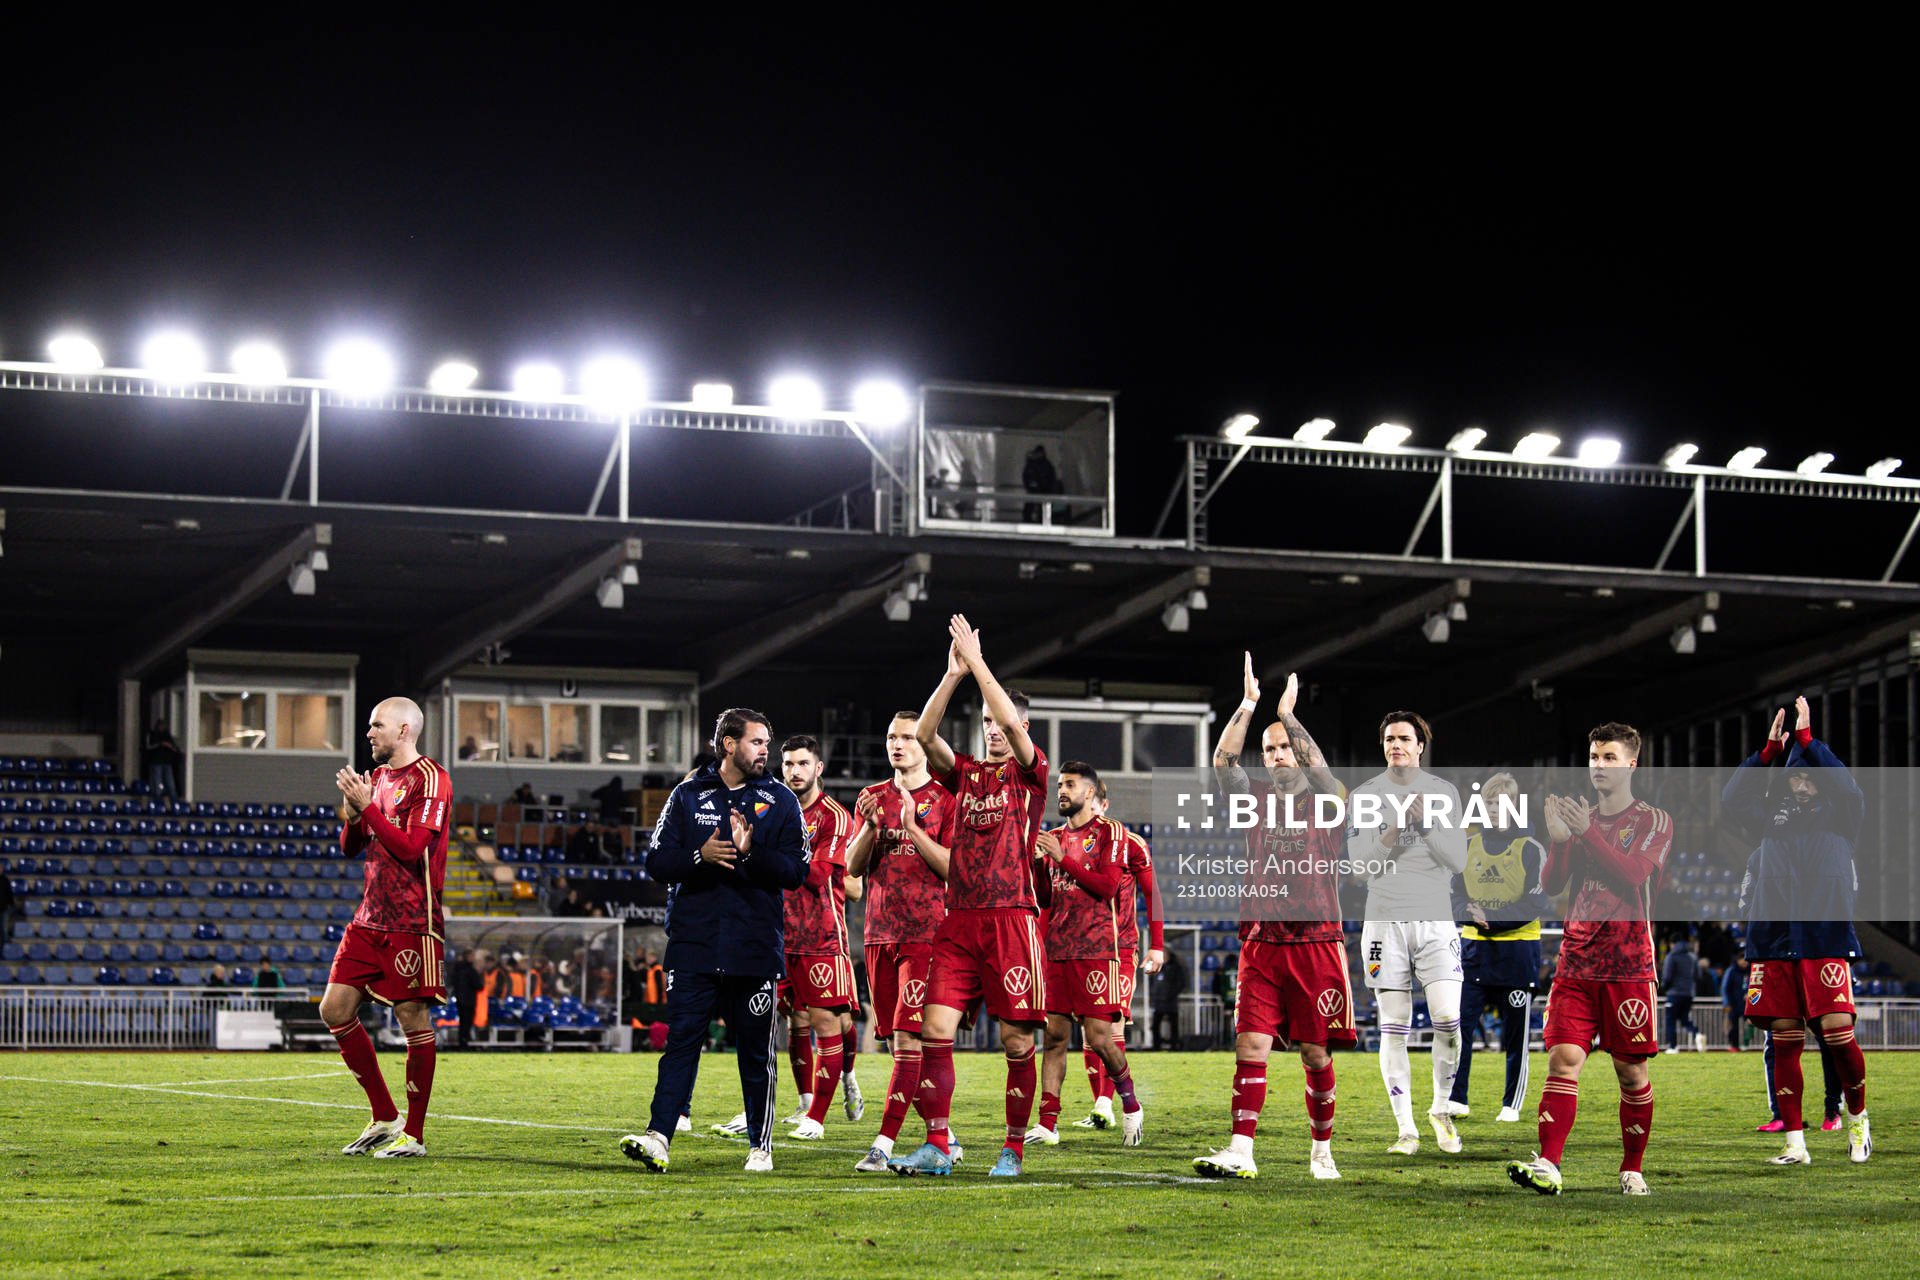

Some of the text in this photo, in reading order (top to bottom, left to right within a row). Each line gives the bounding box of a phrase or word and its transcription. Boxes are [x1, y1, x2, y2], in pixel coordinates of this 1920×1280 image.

[964, 809, 1003, 825] Finans
[1264, 834, 1305, 853] Finans
[1478, 875, 1504, 884] adidas
